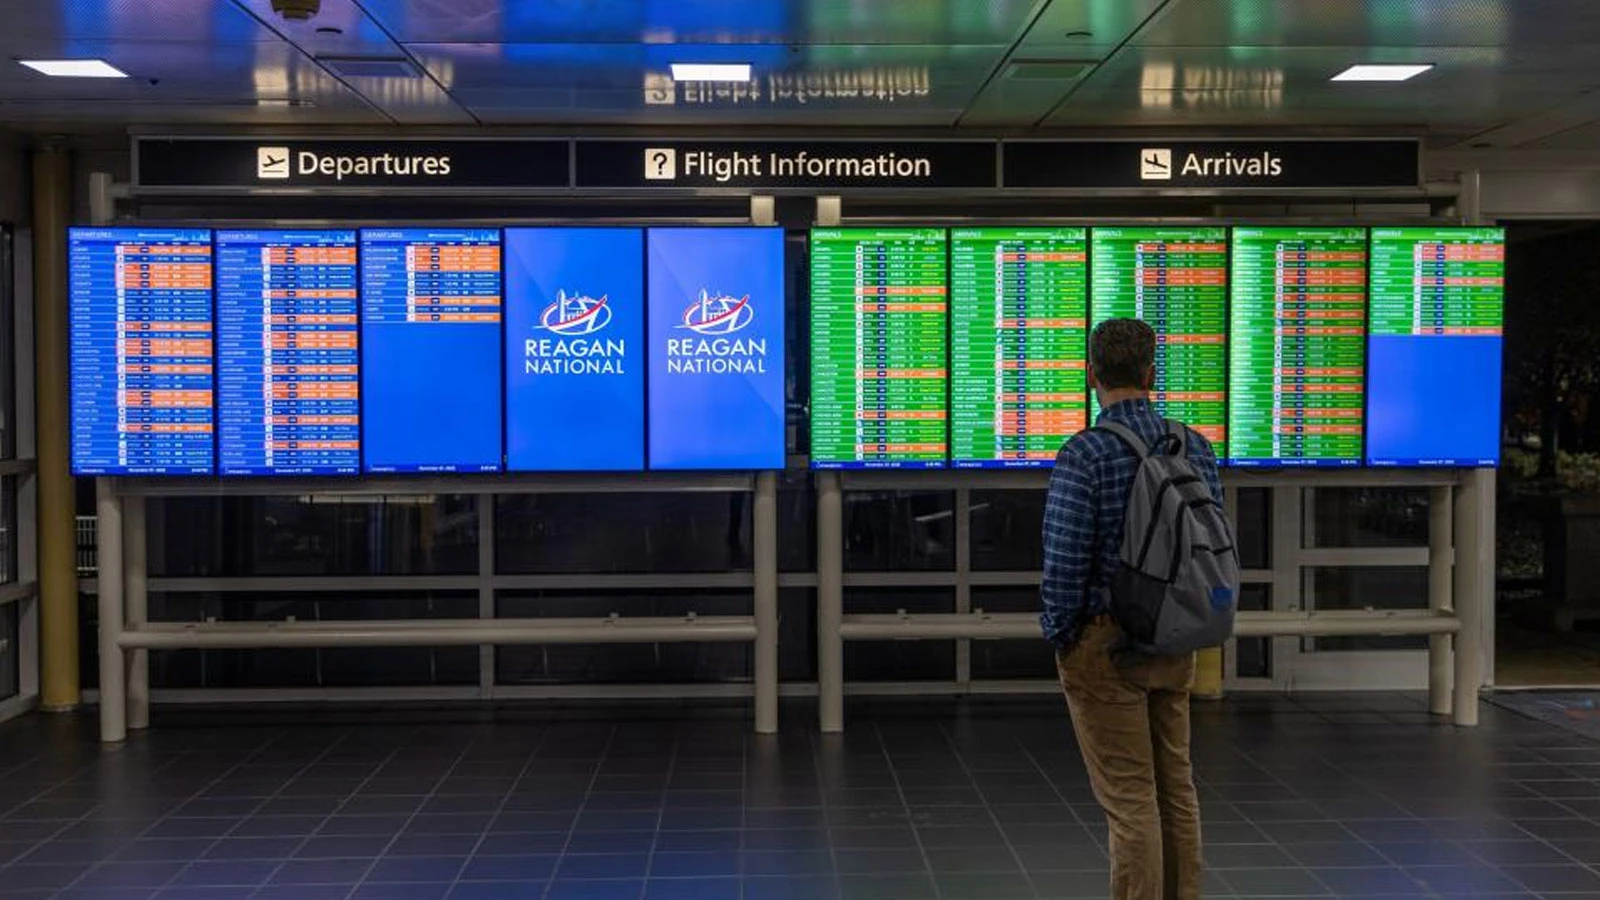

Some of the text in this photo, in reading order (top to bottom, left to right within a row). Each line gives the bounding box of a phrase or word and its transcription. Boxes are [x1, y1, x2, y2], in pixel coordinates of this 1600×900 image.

[298, 151, 451, 181] Departures
[684, 151, 931, 182] Flight Information
[1181, 151, 1282, 176] Arrivals
[525, 339, 625, 357] REAGAN
[667, 339, 766, 357] REAGAN
[525, 359, 625, 374] NATIONAL
[667, 359, 766, 374] NATIONAL
